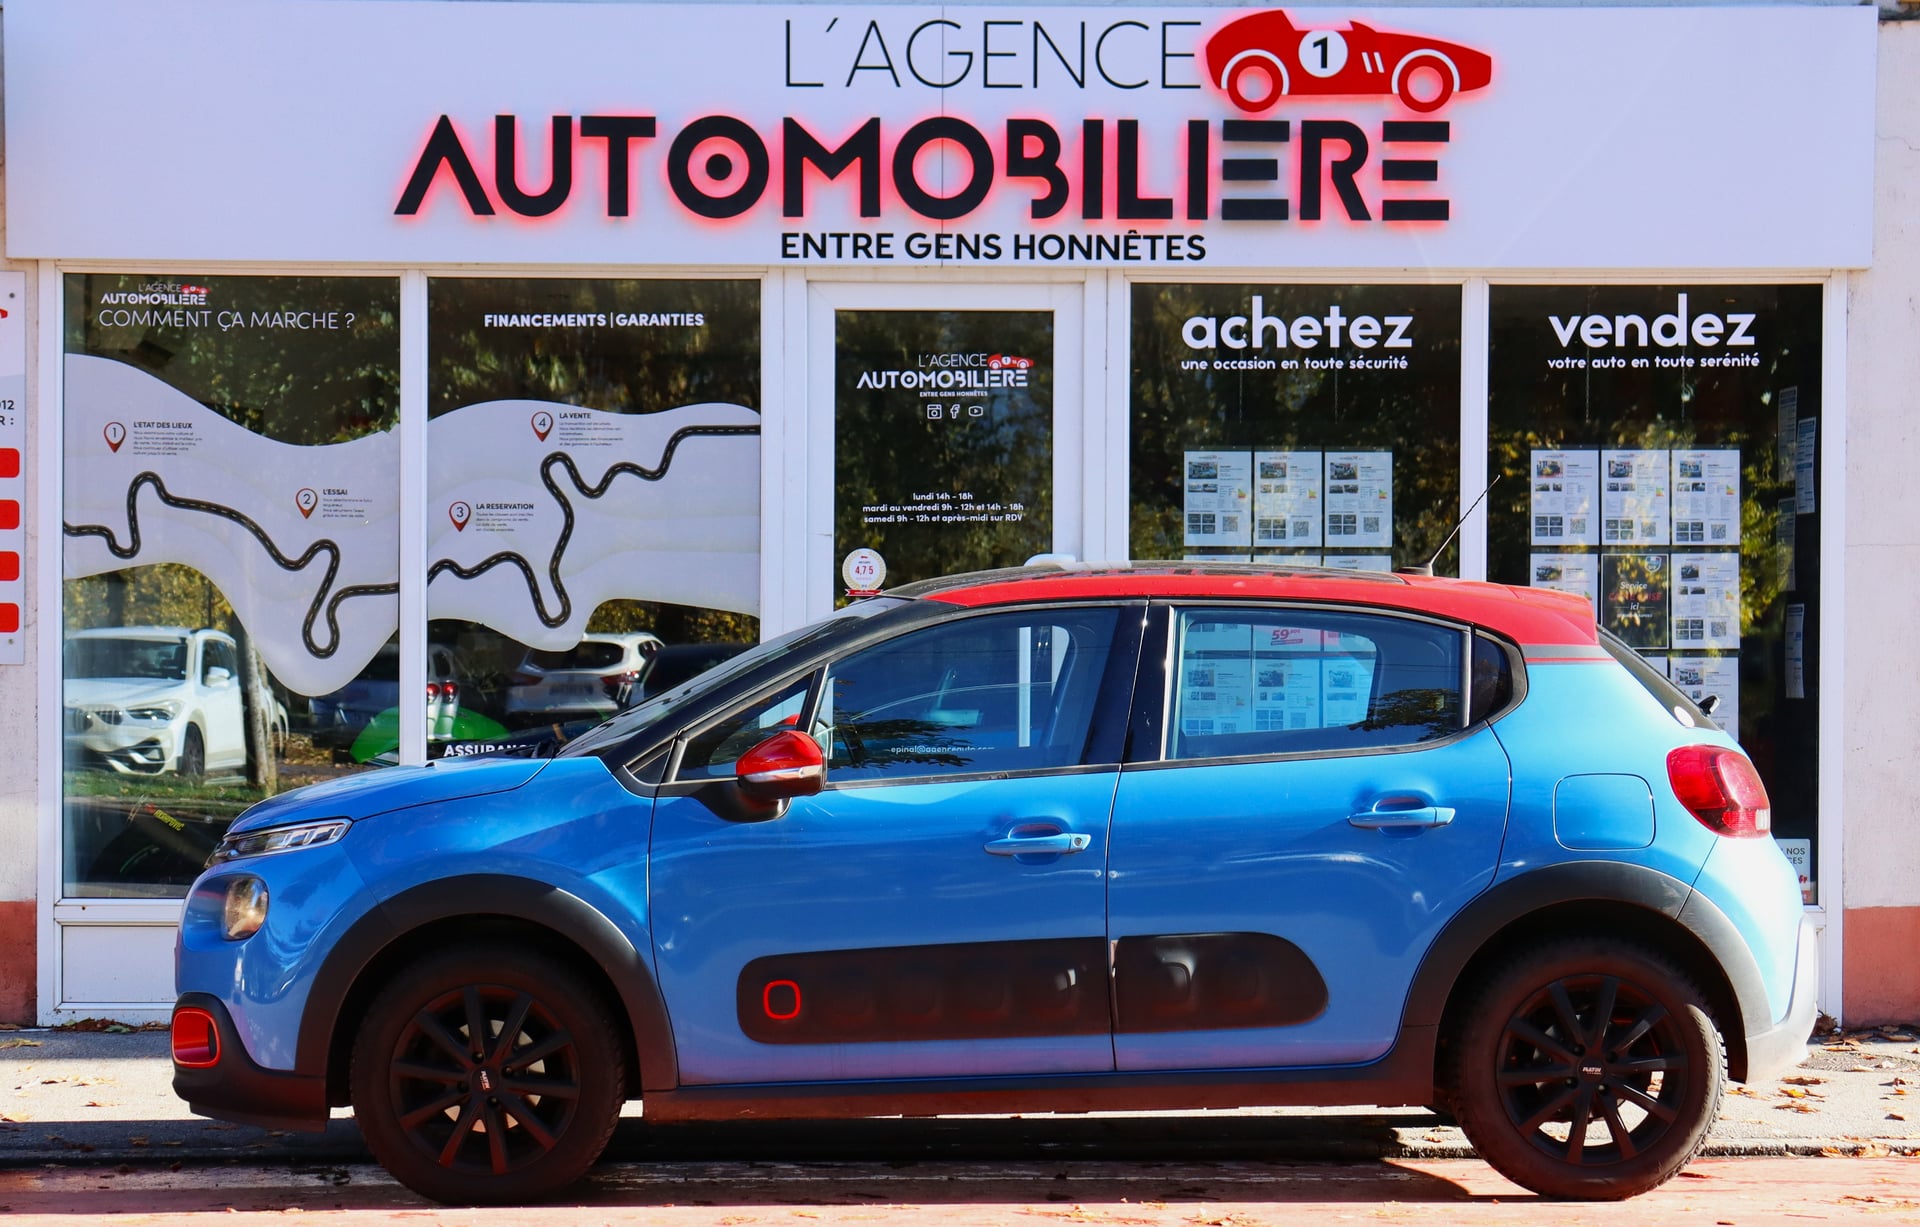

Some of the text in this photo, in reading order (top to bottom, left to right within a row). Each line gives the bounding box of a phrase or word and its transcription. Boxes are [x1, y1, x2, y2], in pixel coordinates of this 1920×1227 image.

[785, 18, 1202, 89] L'AGENCE
[1312, 36, 1329, 69] 1
[393, 114, 1450, 221] AUTOMOBILIERE
[781, 230, 1207, 261] ENTRE GENS HONNÊTES
[138, 283, 182, 292] L'AGENCE
[99, 309, 356, 332] COMMENT ÇA MARCHE ?
[484, 313, 607, 328] FINANCEMENTS
[615, 313, 705, 327] GARANTIES
[1181, 295, 1414, 350] achetez
[1548, 292, 1757, 348] vendez
[918, 353, 988, 368] L'AGENCE
[1181, 354, 1409, 370] une occasion en toute sécurité
[1547, 352, 1760, 369] votre auto en toute serénité
[856, 370, 1029, 389] AUTOMOBILIERE
[0, 399, 15, 410] 12
[133, 421, 156, 429] L'ETAT
[538, 417, 547, 427] 4
[303, 493, 311, 505] 2
[322, 488, 348, 496] L'ESSAI
[912, 492, 934, 501] lundi
[936, 491, 951, 500] 14h
[958, 492, 974, 500] 18h
[456, 506, 464, 518] 3
[862, 503, 888, 512] mardi
[902, 503, 940, 511] vendredi
[941, 502, 953, 511] 9h
[960, 502, 975, 511] 12h
[976, 503, 985, 511] et
[986, 502, 1001, 511] 14h
[1009, 502, 1024, 511] 18h
[864, 514, 895, 523] samedi
[896, 514, 908, 522] 9h
[915, 514, 930, 522] 12h
[931, 514, 940, 522] et
[941, 513, 989, 524] après-midi
[1004, 513, 1023, 522] RDV
[443, 744, 528, 757] ASSUR
[1786, 847, 1806, 855] NOS
